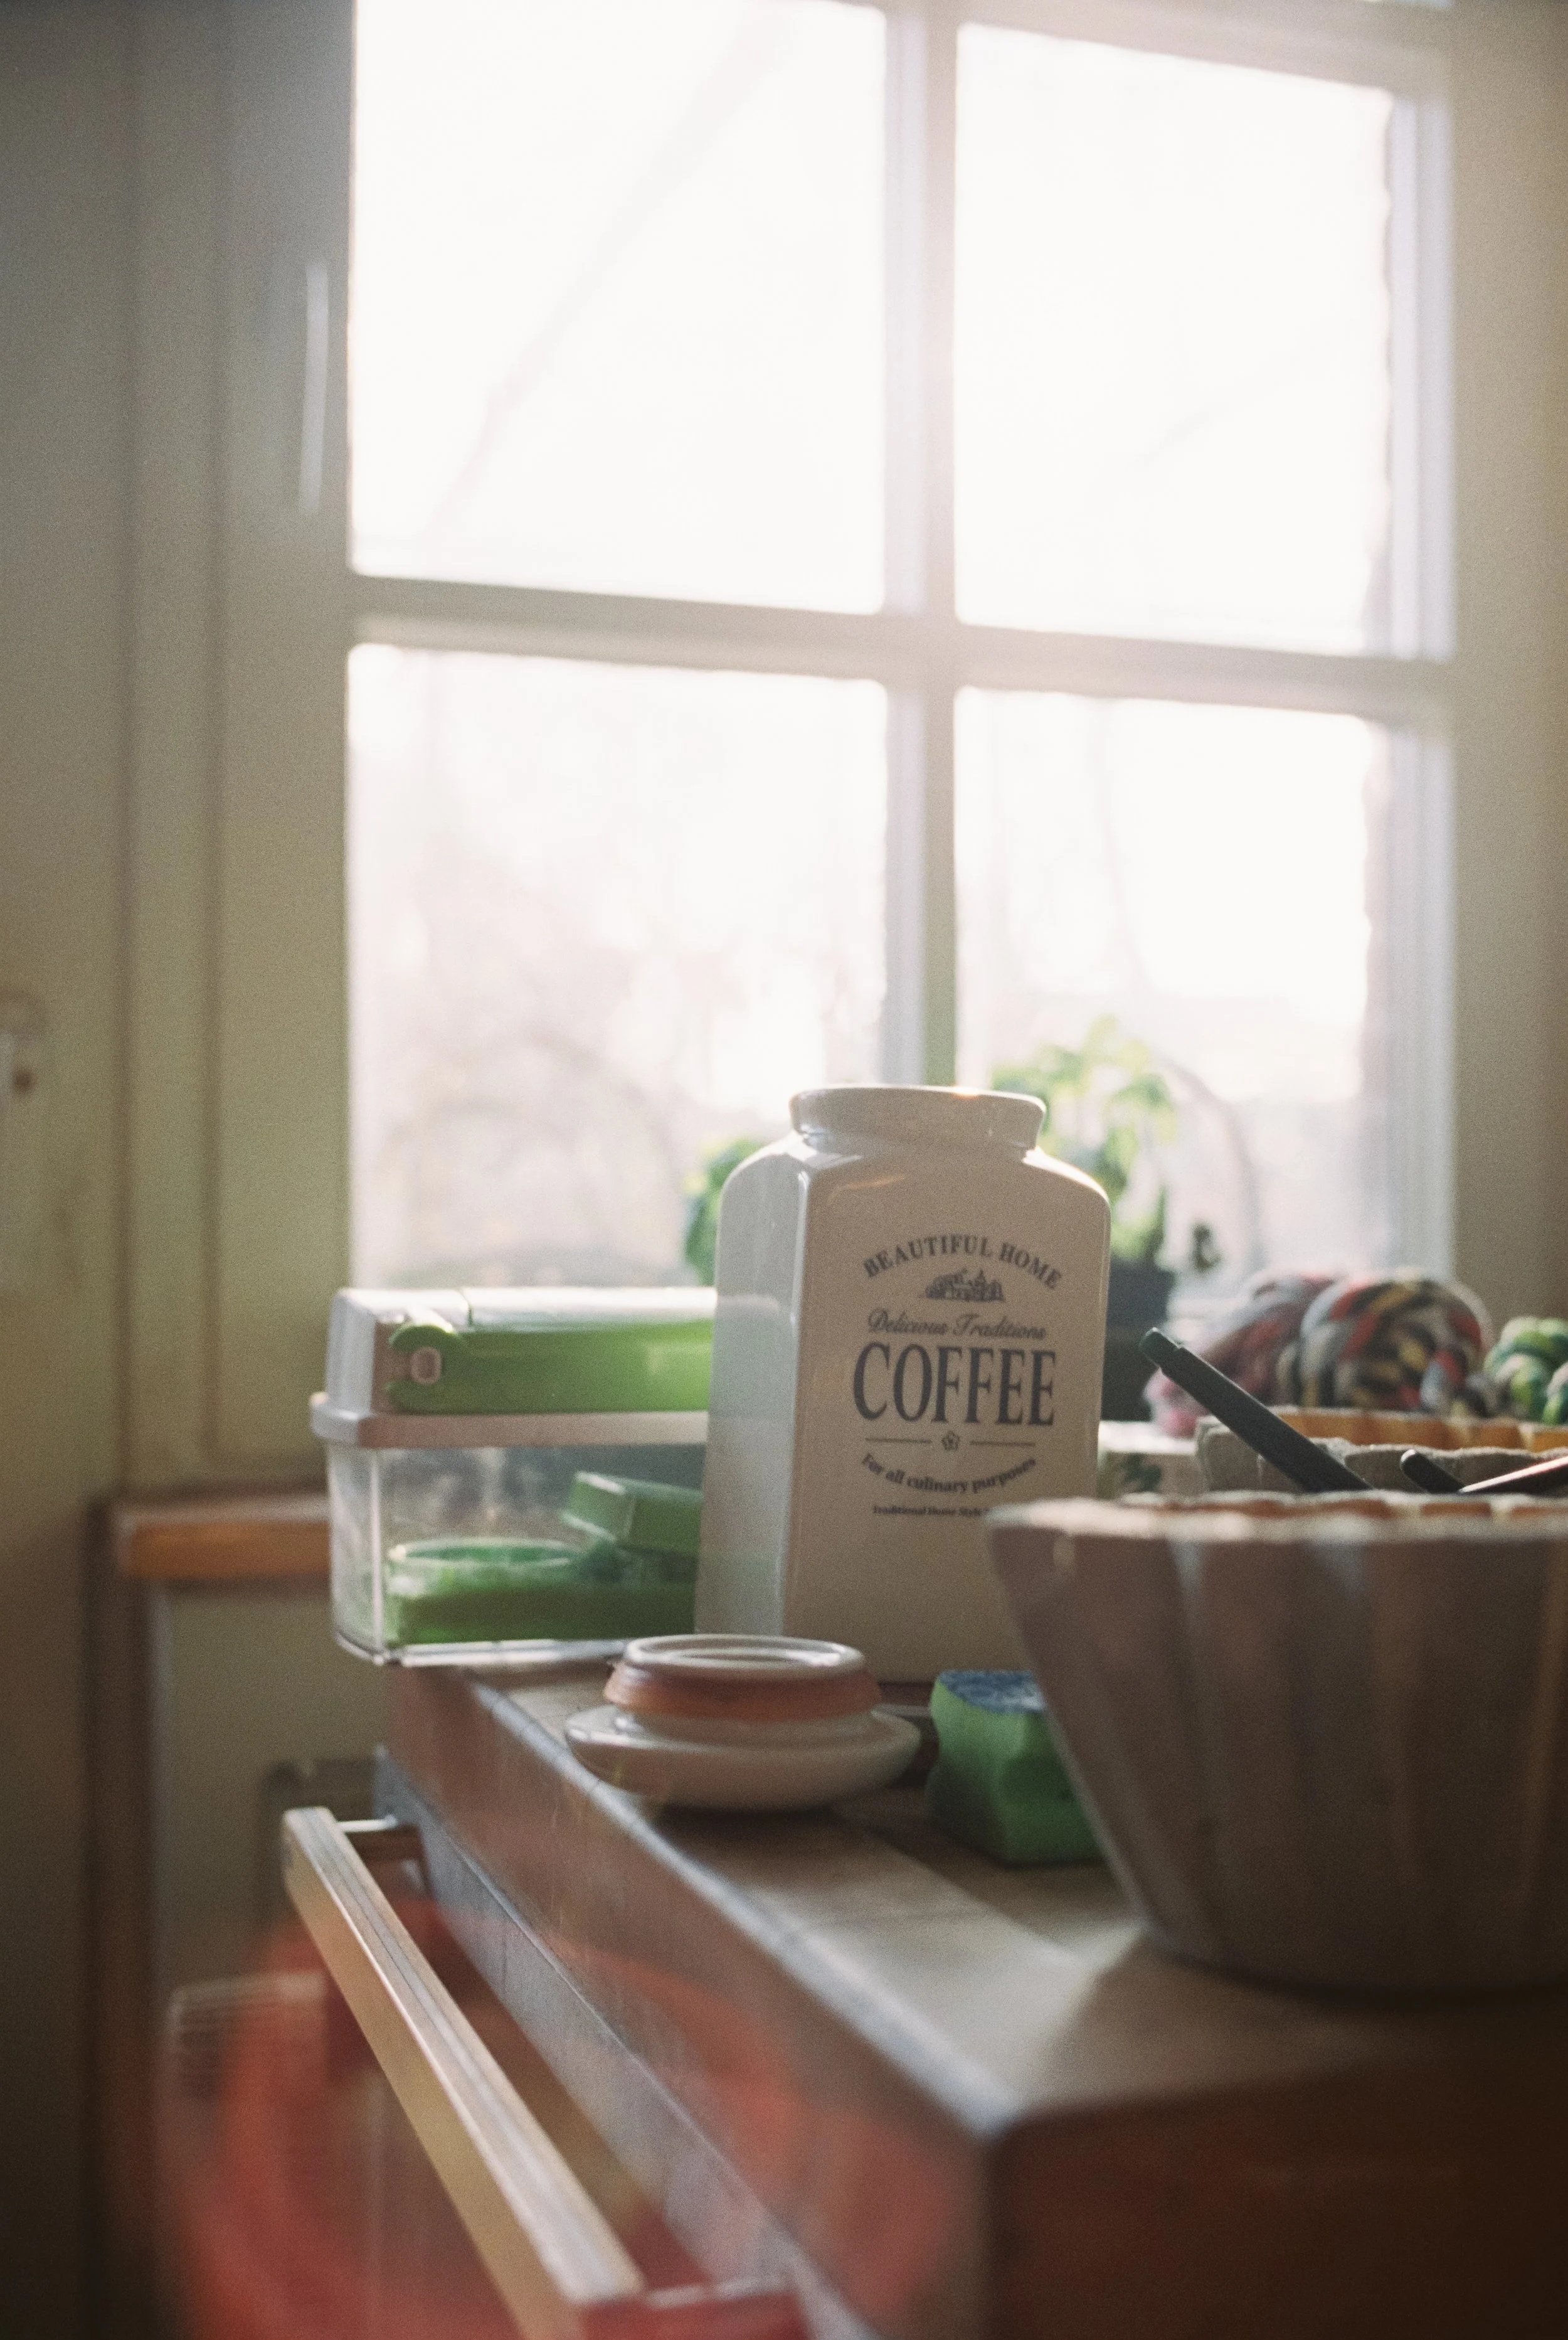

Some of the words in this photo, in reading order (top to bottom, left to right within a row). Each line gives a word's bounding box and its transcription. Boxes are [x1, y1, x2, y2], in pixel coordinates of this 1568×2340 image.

[863, 1234, 993, 1277] BEAUTIFUL
[999, 1242, 1062, 1289] HOME
[867, 1307, 949, 1336] Delicious
[953, 1313, 1047, 1340] Traditions
[853, 1341, 1057, 1426] COFFEE
[885, 1469, 905, 1485] all
[907, 1476, 968, 1494] culinary
[972, 1458, 1037, 1494] purposes
